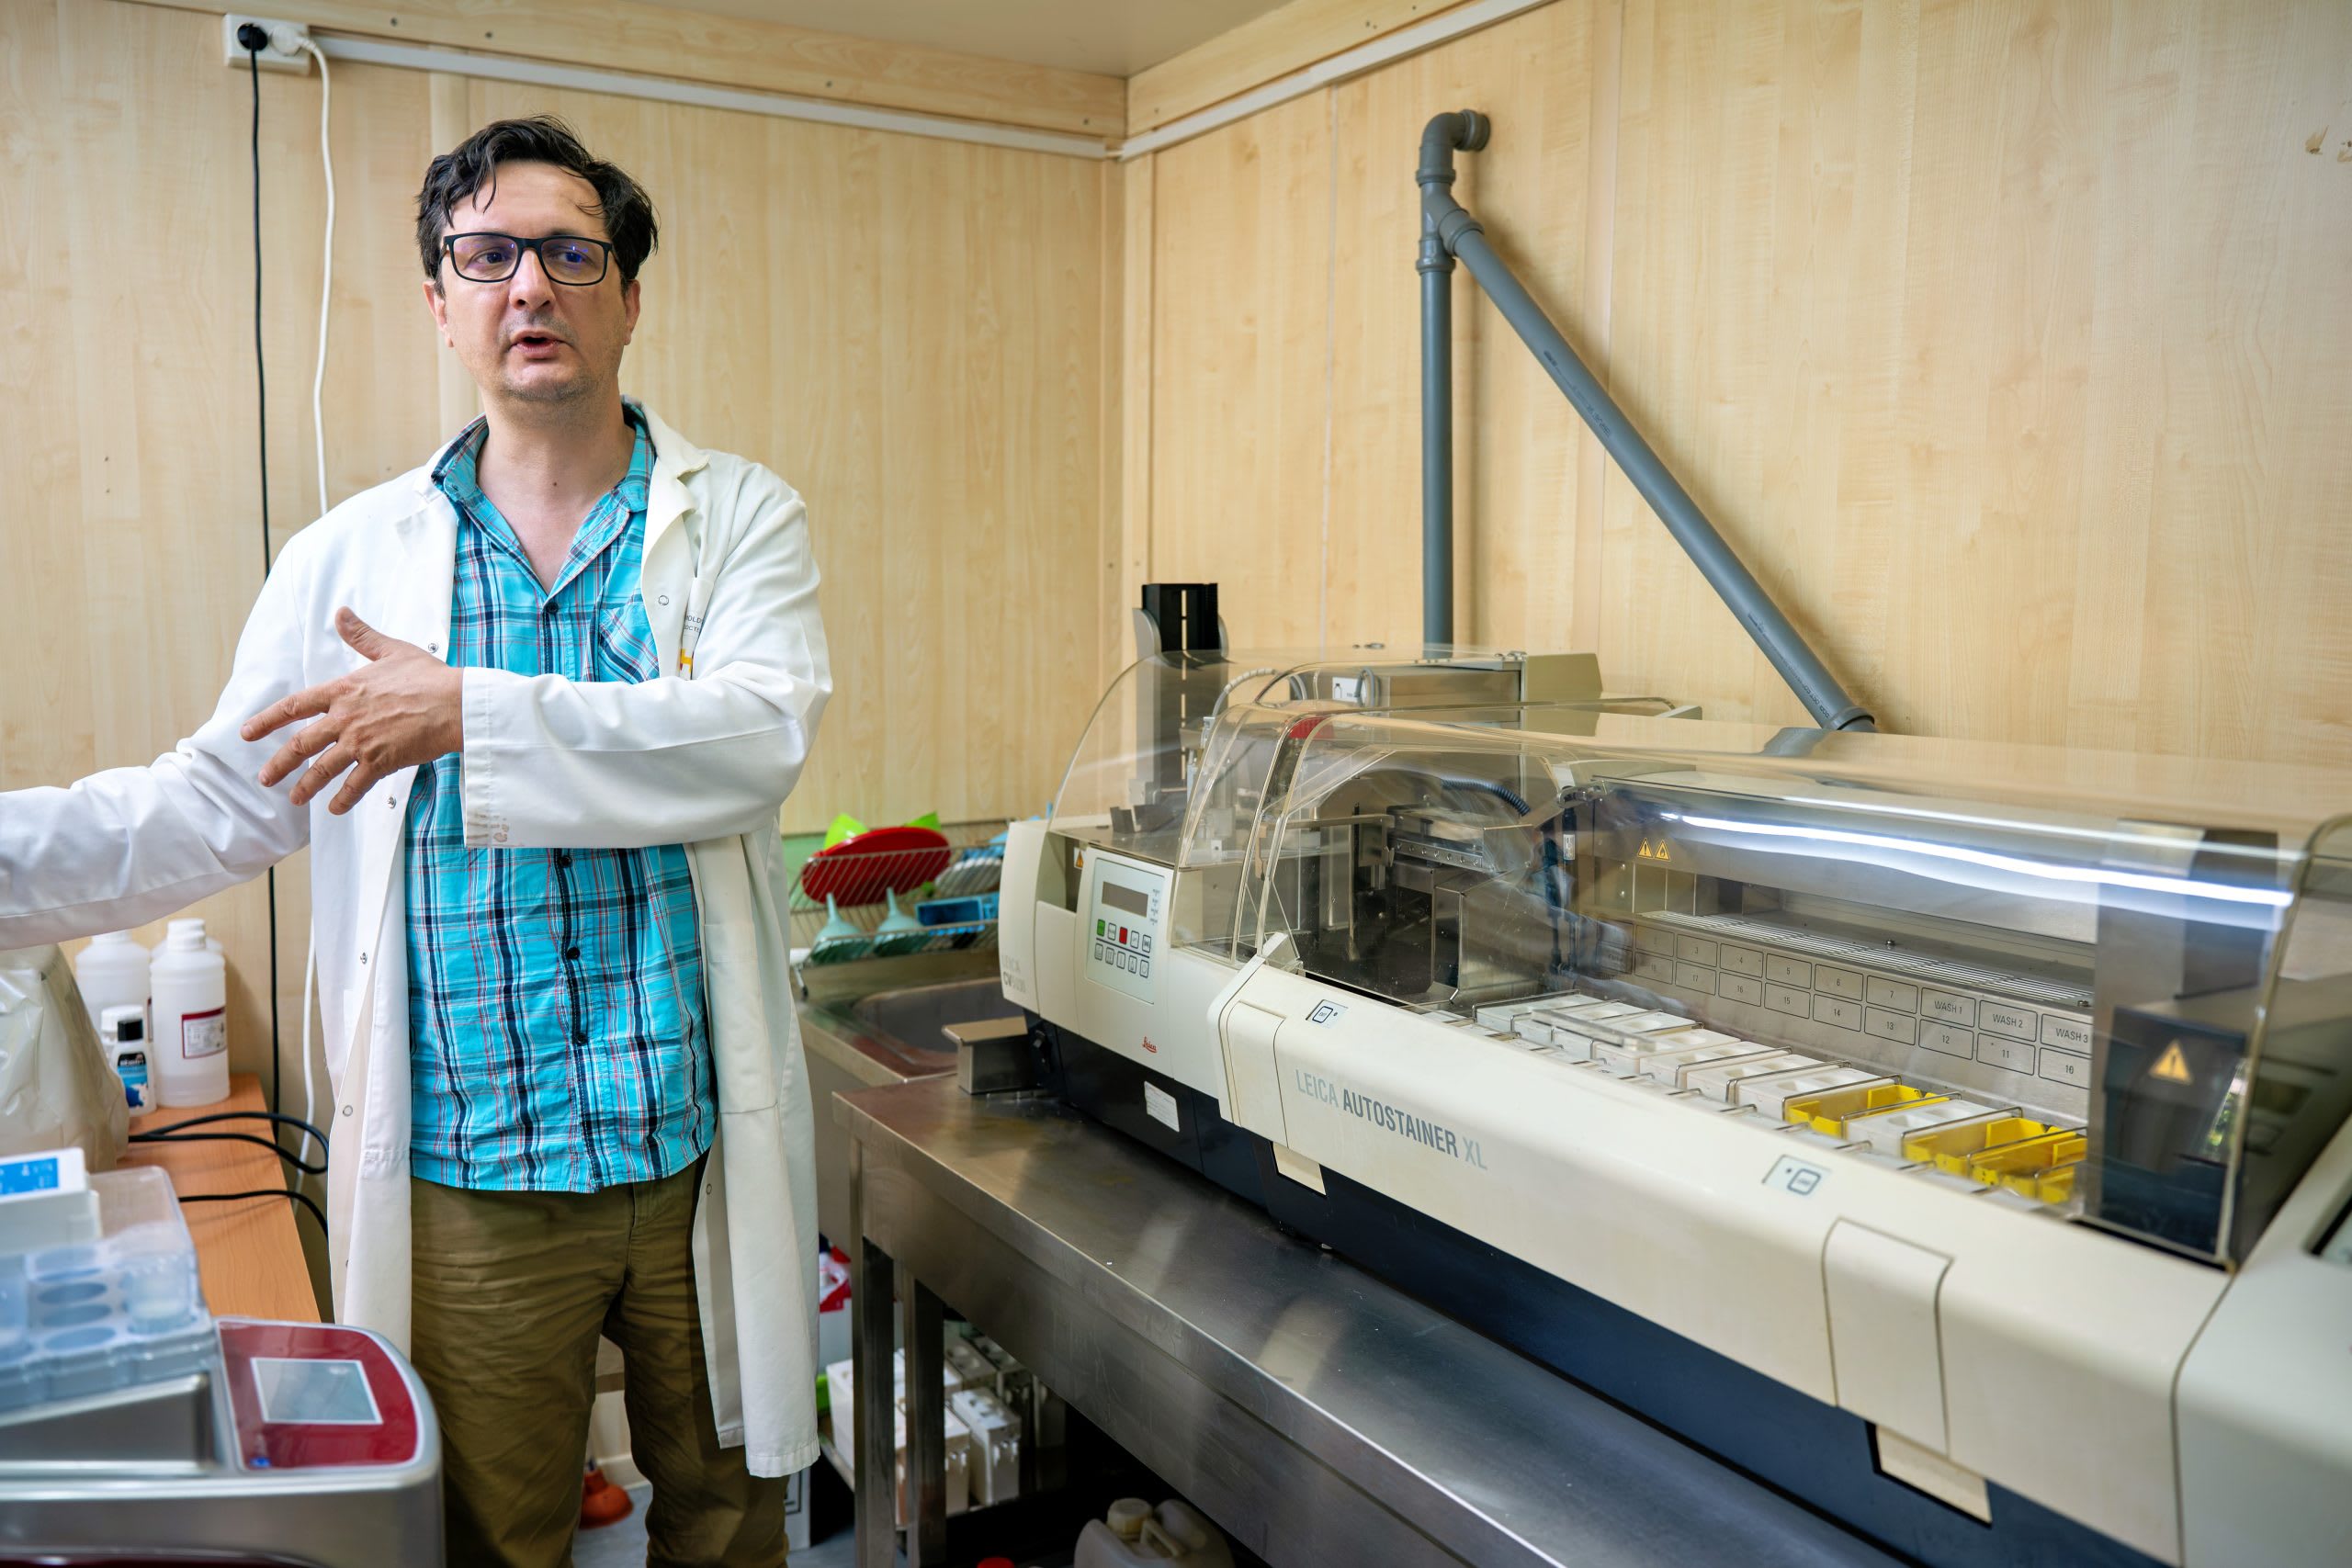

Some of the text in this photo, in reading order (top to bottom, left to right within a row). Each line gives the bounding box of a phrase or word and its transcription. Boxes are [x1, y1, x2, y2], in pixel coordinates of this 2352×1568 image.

[1694, 946, 1699, 954] 3
[1890, 990, 1894, 998] 7
[1934, 1000, 1962, 1014] WASH 1
[1834, 1009, 1840, 1017] 14
[1886, 1021, 1894, 1030] 13
[1992, 1013, 2023, 1028] WASH 2
[1941, 1034, 1950, 1044] 12
[2055, 1028, 2088, 1043] WASH 3
[2002, 1049, 2010, 1058] 11
[2064, 1065, 2075, 1075] 10
[1295, 1069, 1487, 1170] LEICA AUTOSTAINER XL
